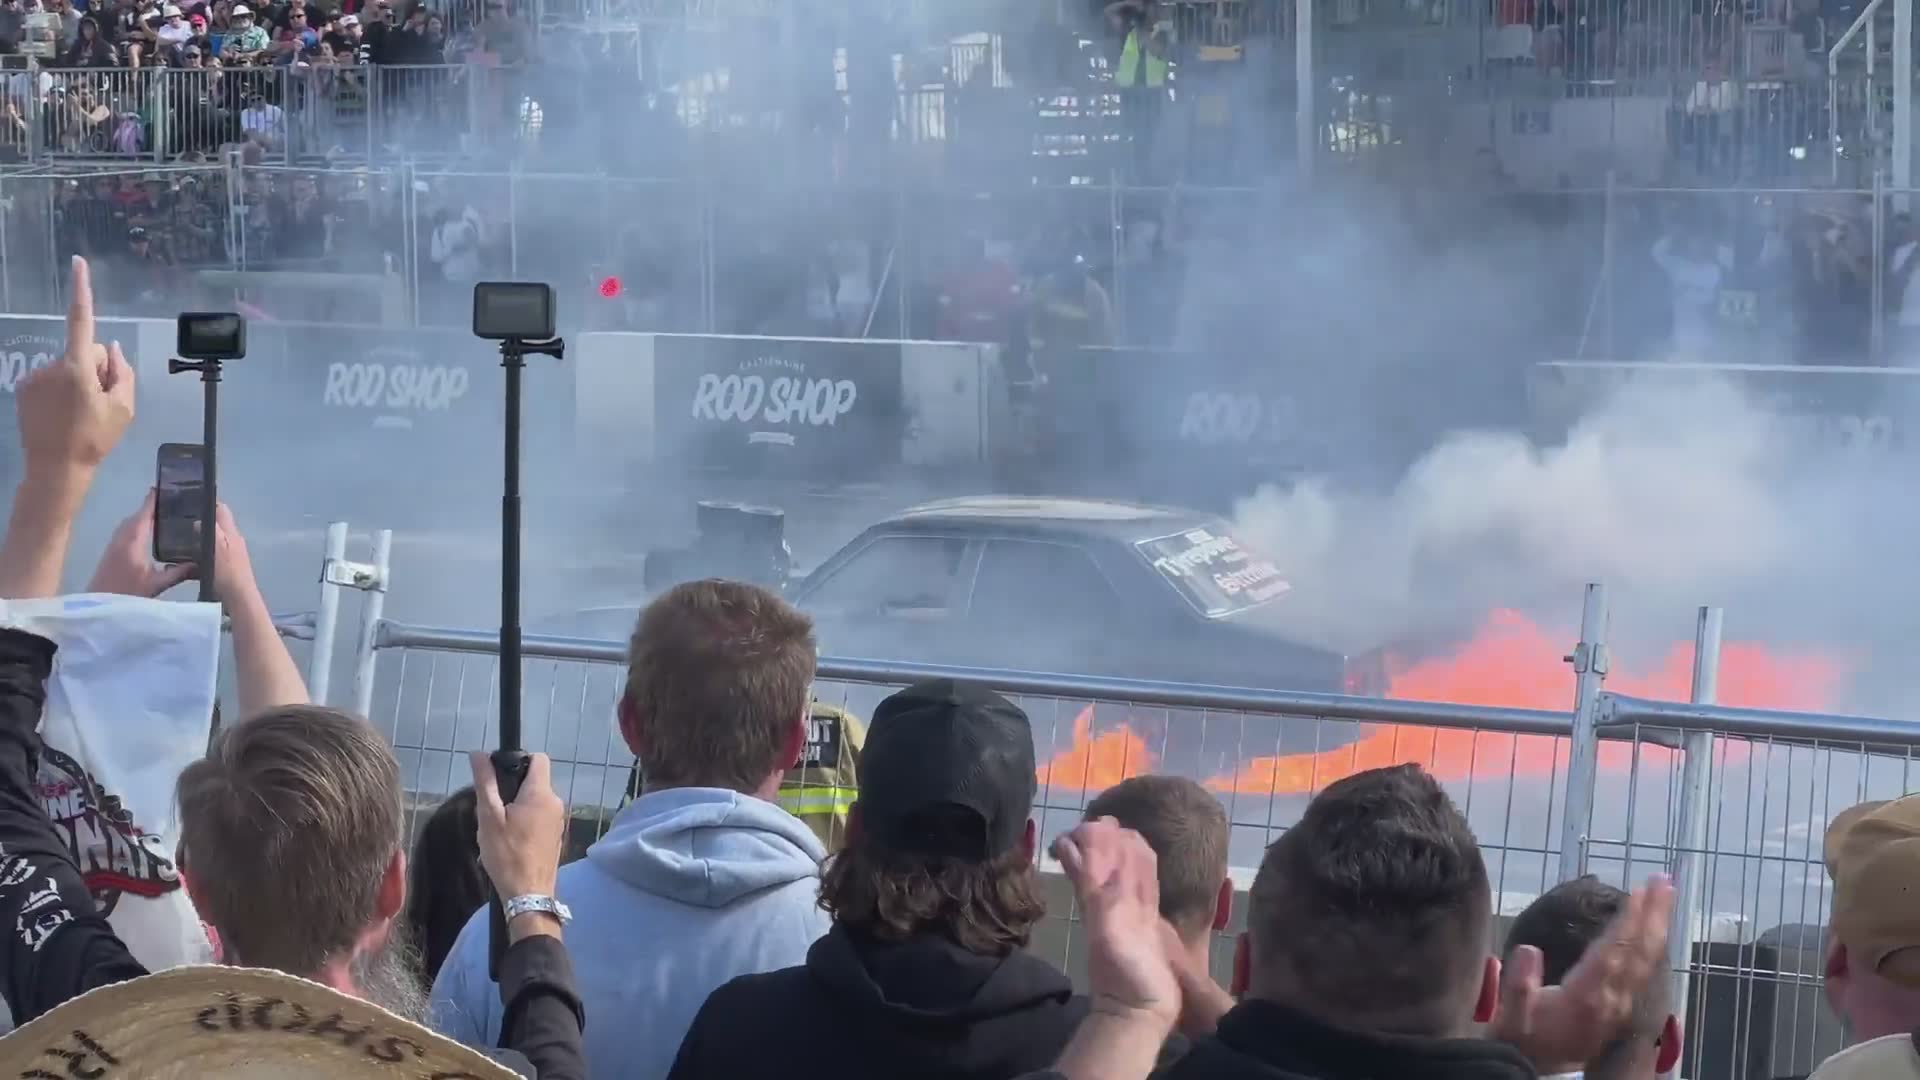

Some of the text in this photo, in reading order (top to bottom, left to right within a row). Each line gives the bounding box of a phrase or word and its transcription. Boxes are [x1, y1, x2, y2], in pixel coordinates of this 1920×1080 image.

[323, 362, 470, 412] ROD SHOP
[692, 373, 857, 426] ROD SHOP
